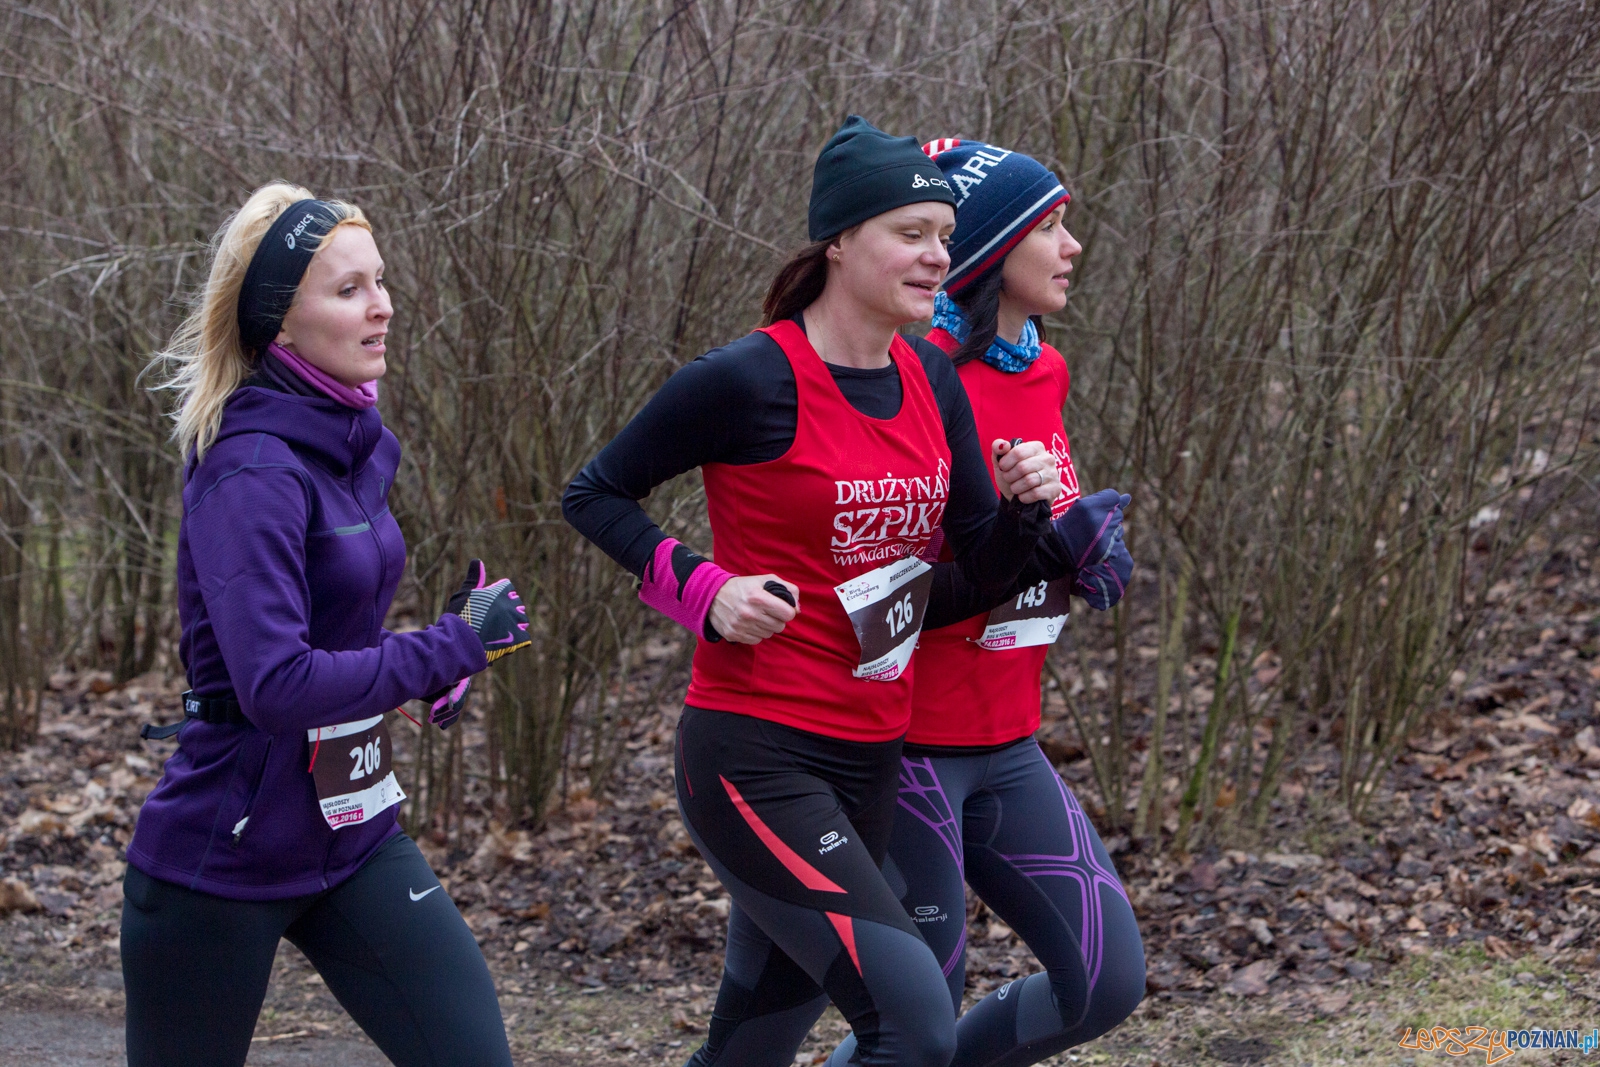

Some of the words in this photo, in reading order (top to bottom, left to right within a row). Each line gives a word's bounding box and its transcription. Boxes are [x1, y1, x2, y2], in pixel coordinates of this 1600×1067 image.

[293, 214, 314, 237] asics
[835, 472, 945, 505] DRUŻYNA
[1016, 580, 1048, 610] 143
[886, 592, 913, 638] 126
[349, 736, 381, 781] 206
[818, 836, 849, 855] Kalenji
